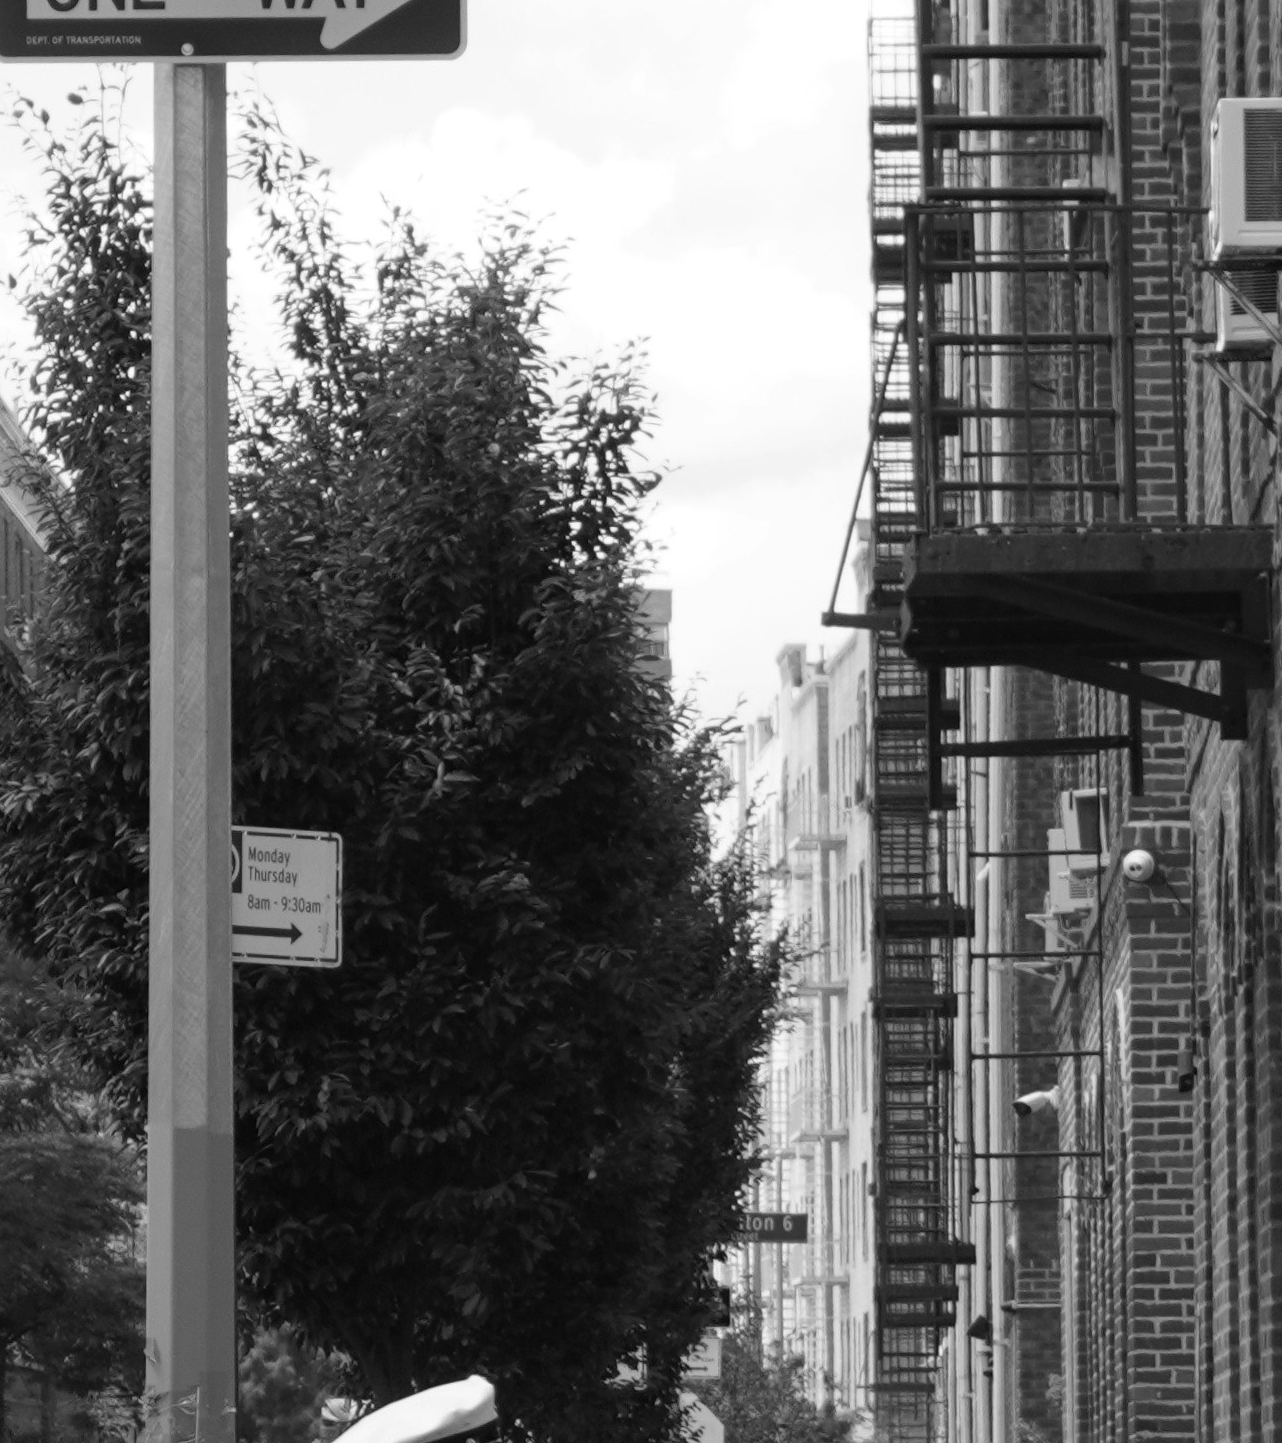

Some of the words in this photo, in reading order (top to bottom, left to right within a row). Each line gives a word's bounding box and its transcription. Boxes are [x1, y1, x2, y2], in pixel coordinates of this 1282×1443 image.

[26, 35, 50, 45] DEPT.
[51, 35, 64, 45] OF
[66, 35, 142, 45] TRANSPORTATION
[248, 846, 291, 867] Monday
[248, 865, 298, 887] Thursday
[247, 894, 271, 910] 8am
[281, 896, 321, 914] 9:30am
[740, 1215, 774, 1231] ton
[782, 1215, 793, 1232] 6
